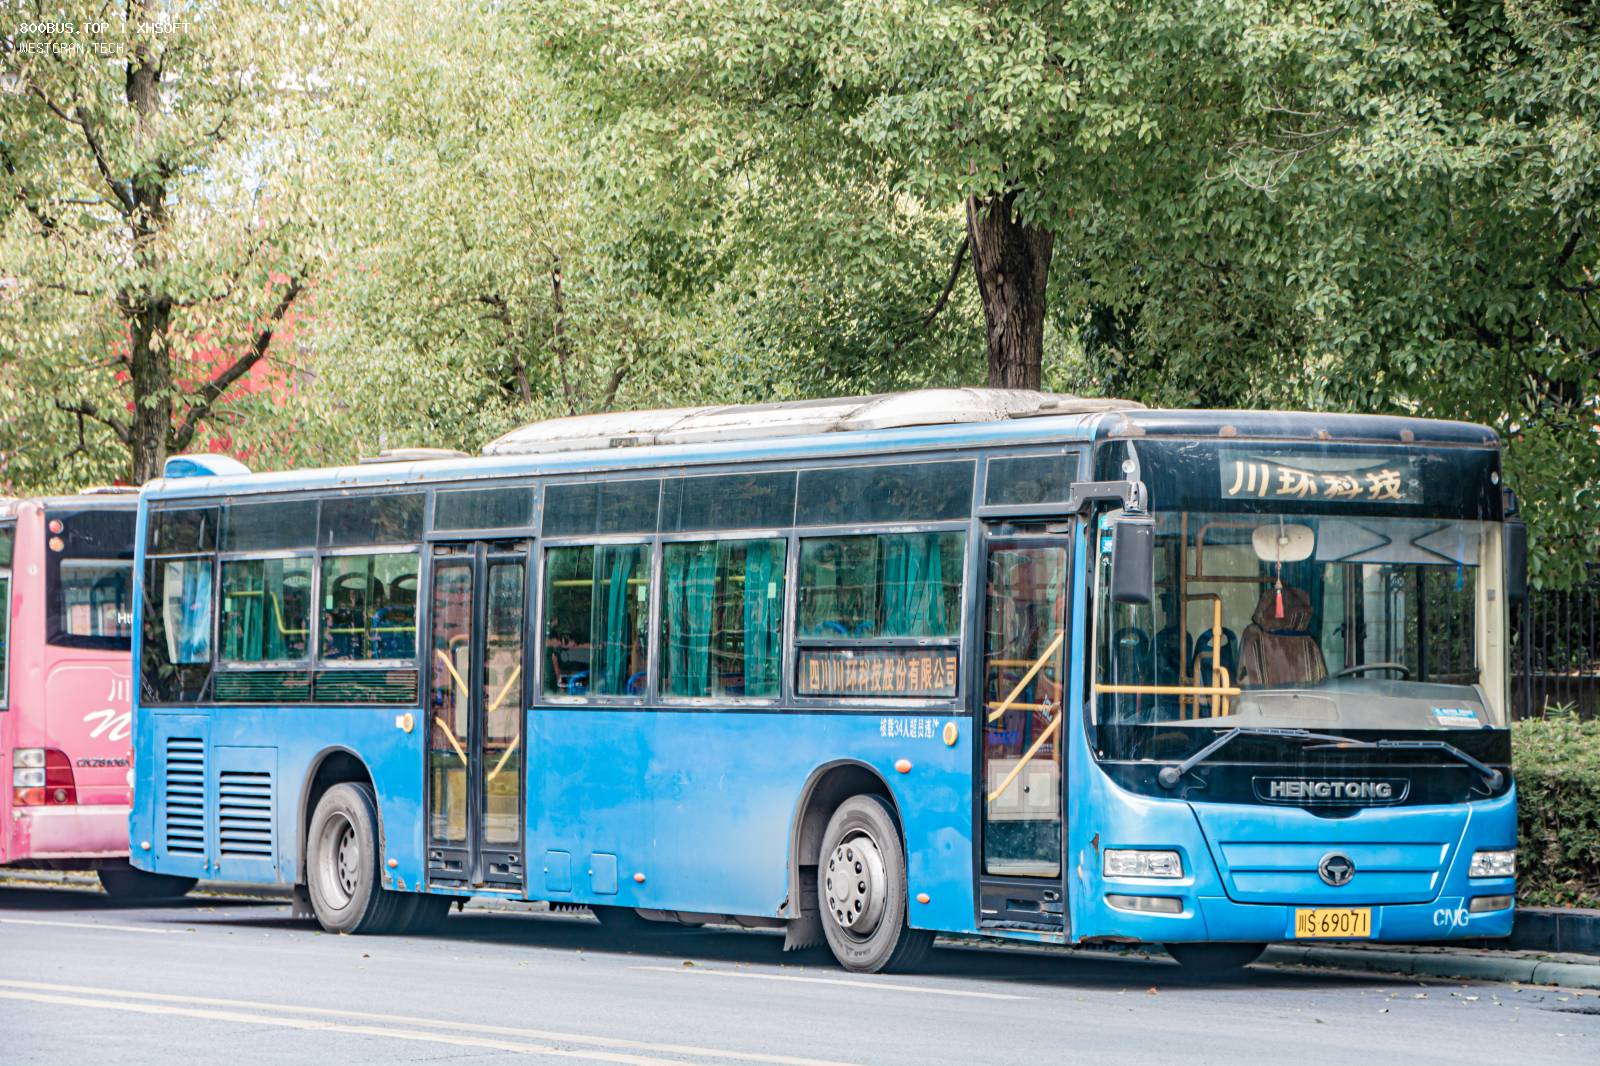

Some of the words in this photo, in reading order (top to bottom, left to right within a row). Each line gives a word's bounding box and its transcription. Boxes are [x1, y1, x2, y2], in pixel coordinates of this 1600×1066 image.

[1228, 461, 1401, 500] 川环科技
[1270, 781, 1392, 798] HENGTONG
[1433, 908, 1469, 927] CNG
